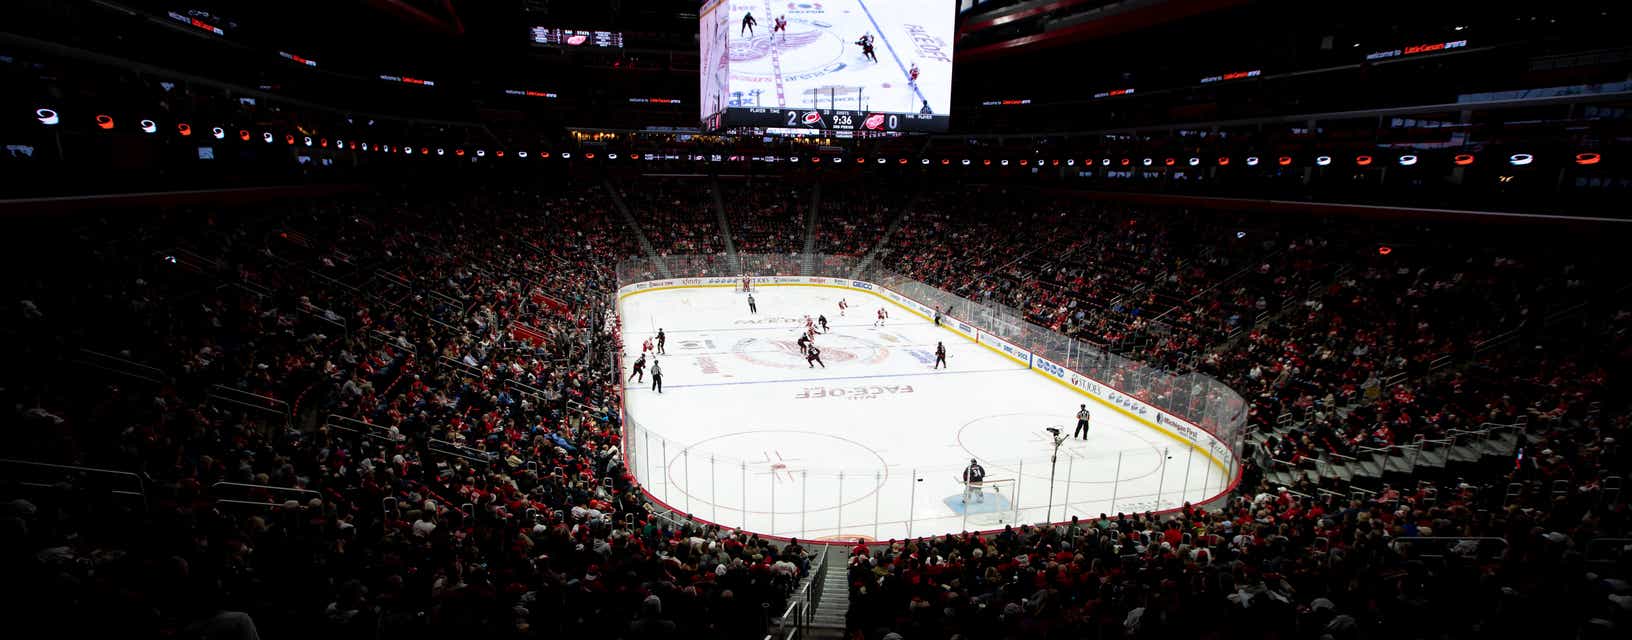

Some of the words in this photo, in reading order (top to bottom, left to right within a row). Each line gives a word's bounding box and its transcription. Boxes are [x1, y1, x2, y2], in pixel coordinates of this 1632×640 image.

[788, 111, 797, 126] 2
[833, 115, 852, 125] 9:36
[889, 115, 897, 129] 0
[853, 281, 873, 290] GEICO
[1163, 416, 1186, 432] Michigan
